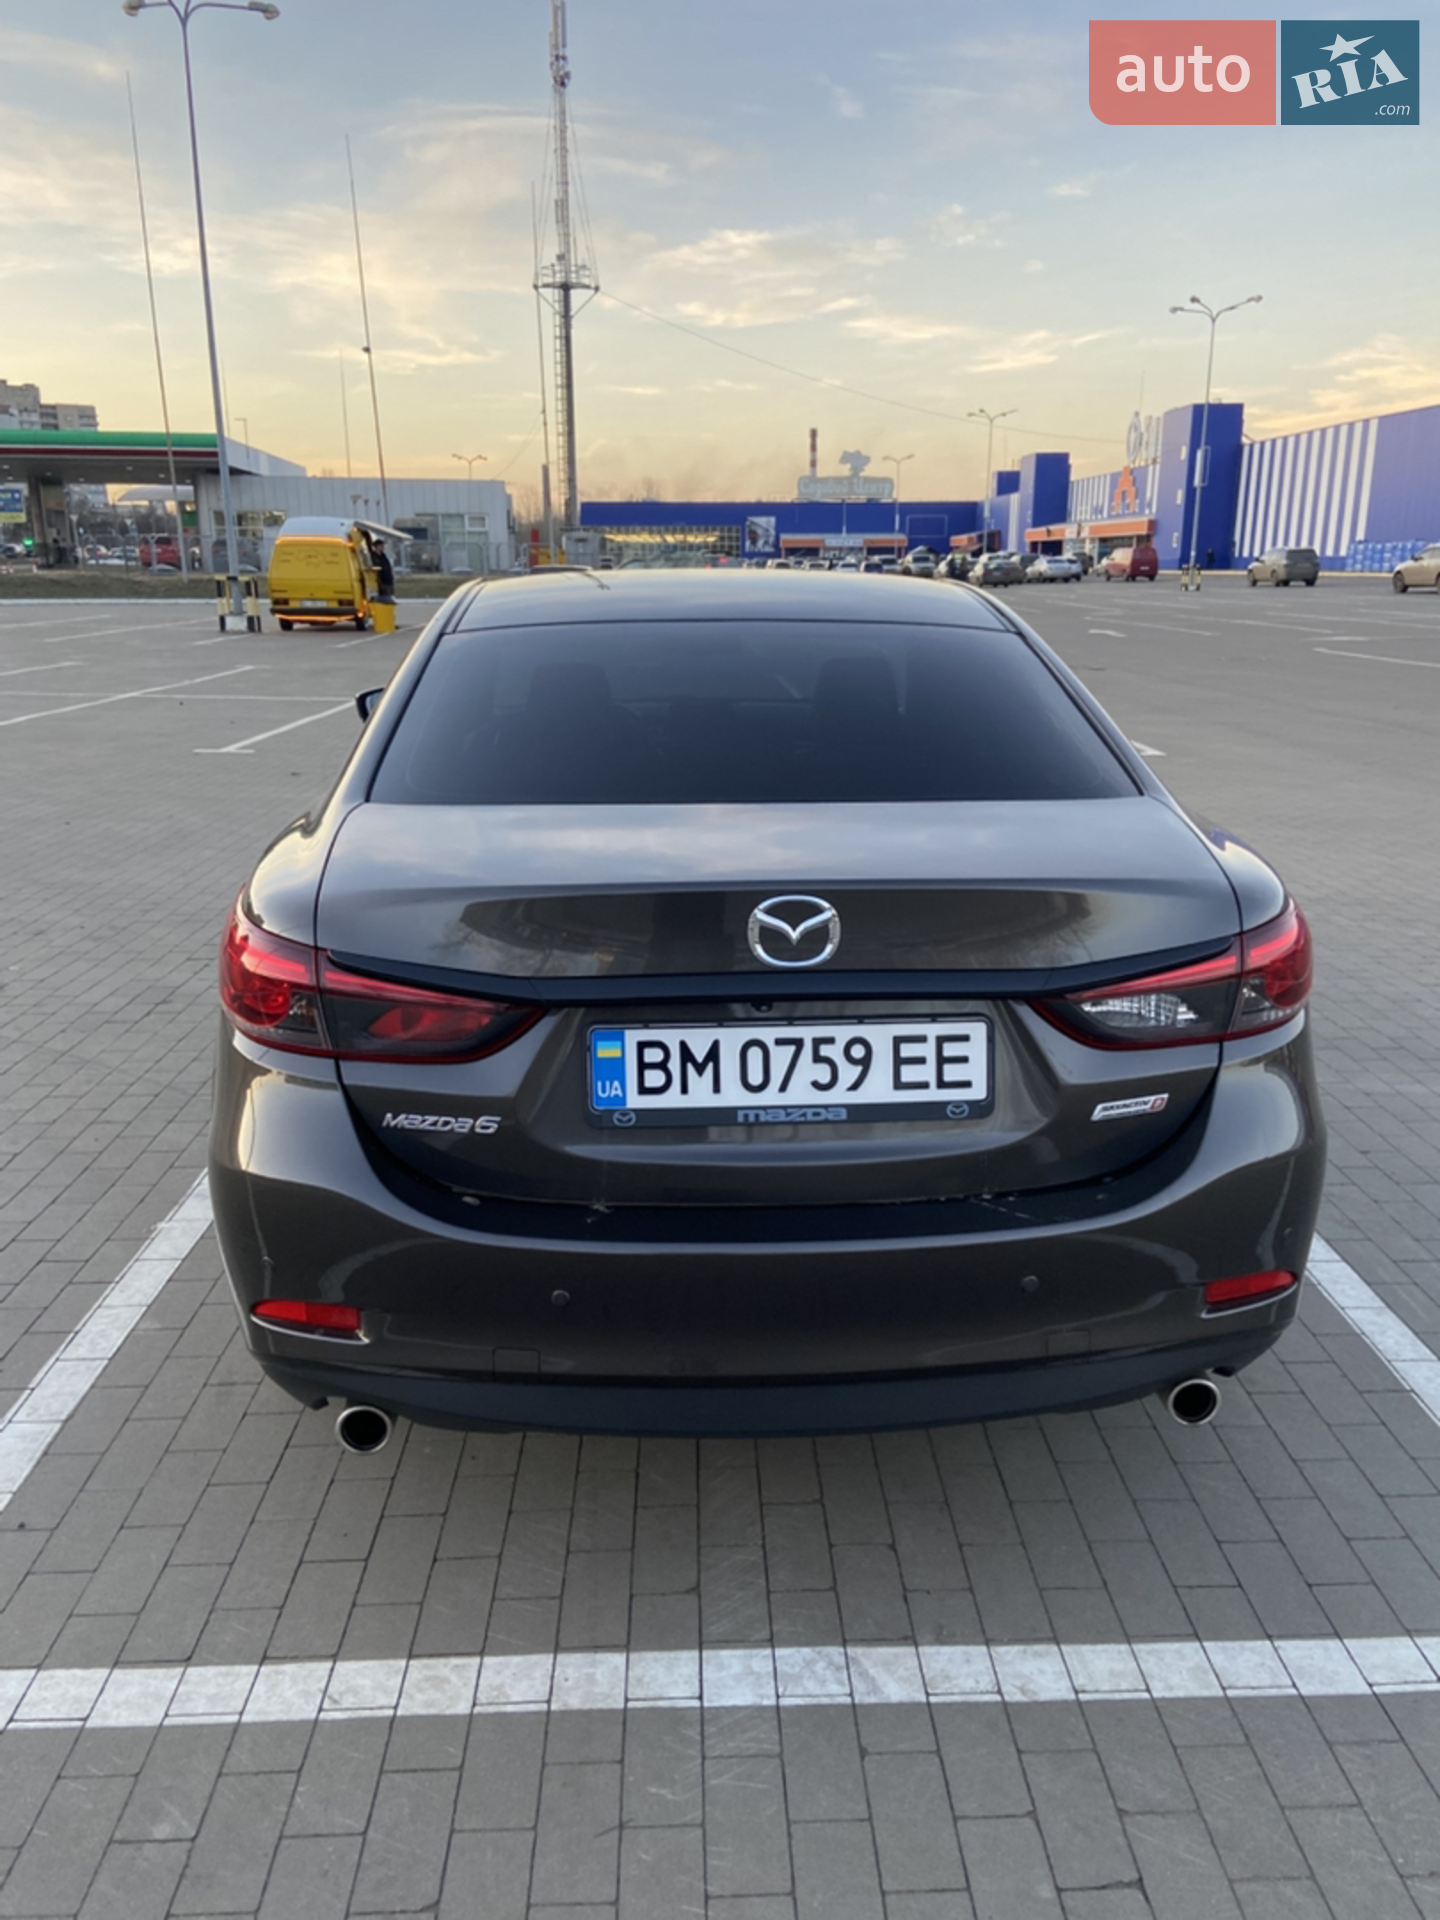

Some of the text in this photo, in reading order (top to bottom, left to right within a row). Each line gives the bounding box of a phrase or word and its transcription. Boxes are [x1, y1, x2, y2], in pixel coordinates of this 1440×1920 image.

[635, 1033, 973, 1096] BM 0759 EE
[597, 1081, 623, 1098] UA
